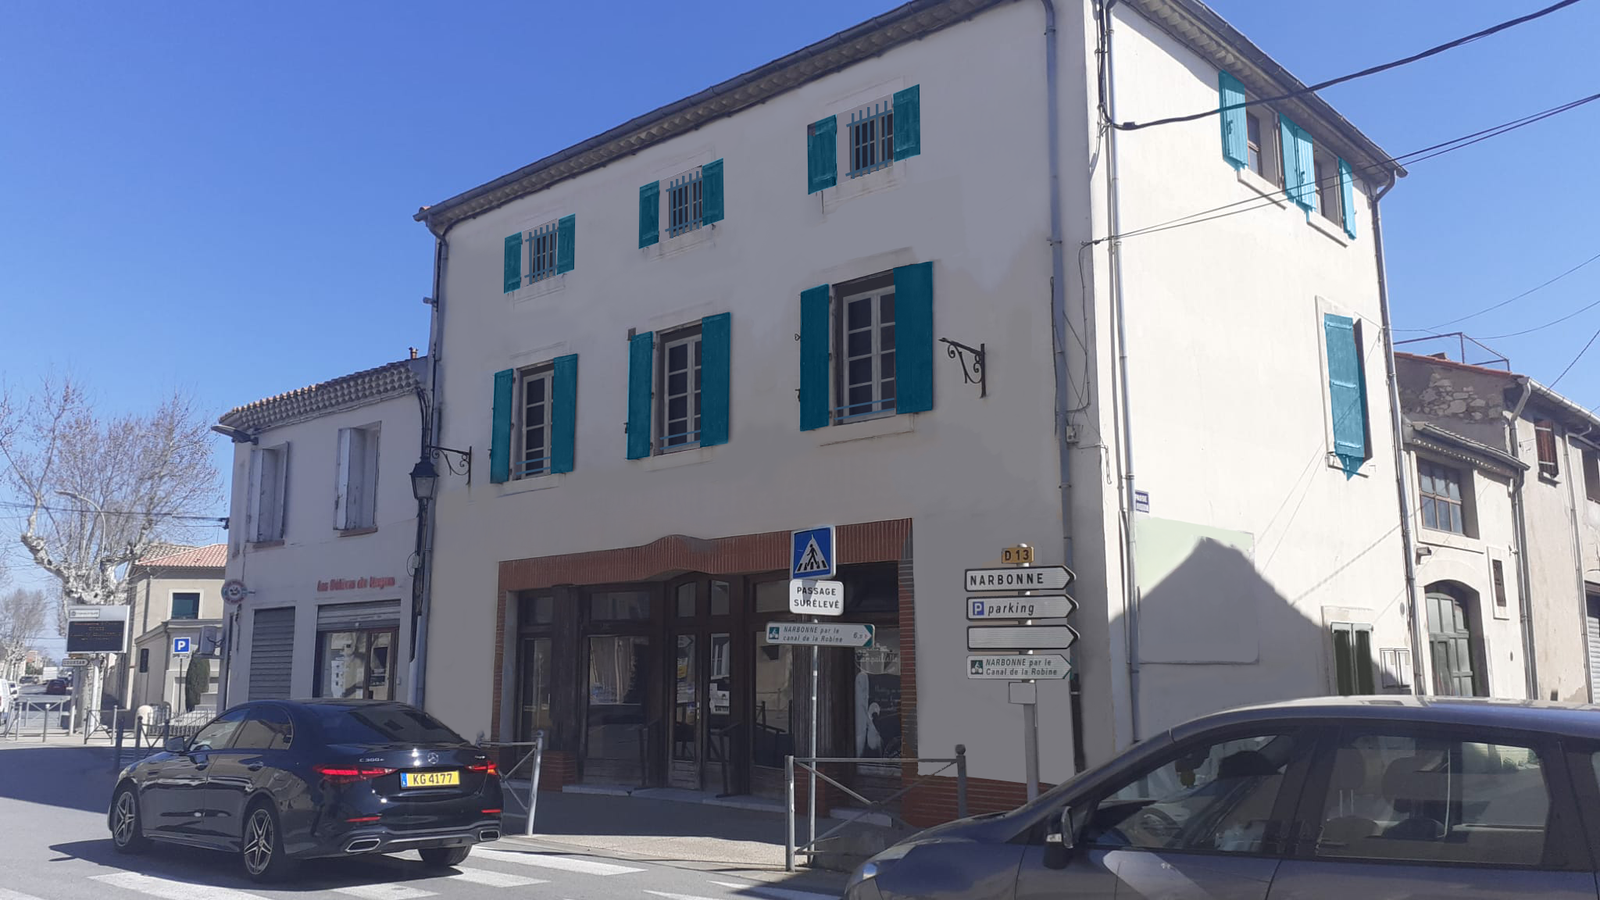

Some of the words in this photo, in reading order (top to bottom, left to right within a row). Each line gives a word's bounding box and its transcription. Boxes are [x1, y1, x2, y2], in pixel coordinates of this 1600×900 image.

[1004, 550, 1012, 560] D
[1016, 550, 1029, 560] 13
[970, 573, 1044, 586] NARBONNE
[796, 587, 836, 596] PASSAGE
[794, 599, 840, 608] SURÉLEVÉ
[988, 602, 1034, 616] parking
[178, 641, 186, 650] P
[986, 658, 1026, 666] NARBONNE
[413, 774, 426, 784] KG
[428, 773, 452, 784] 4177
